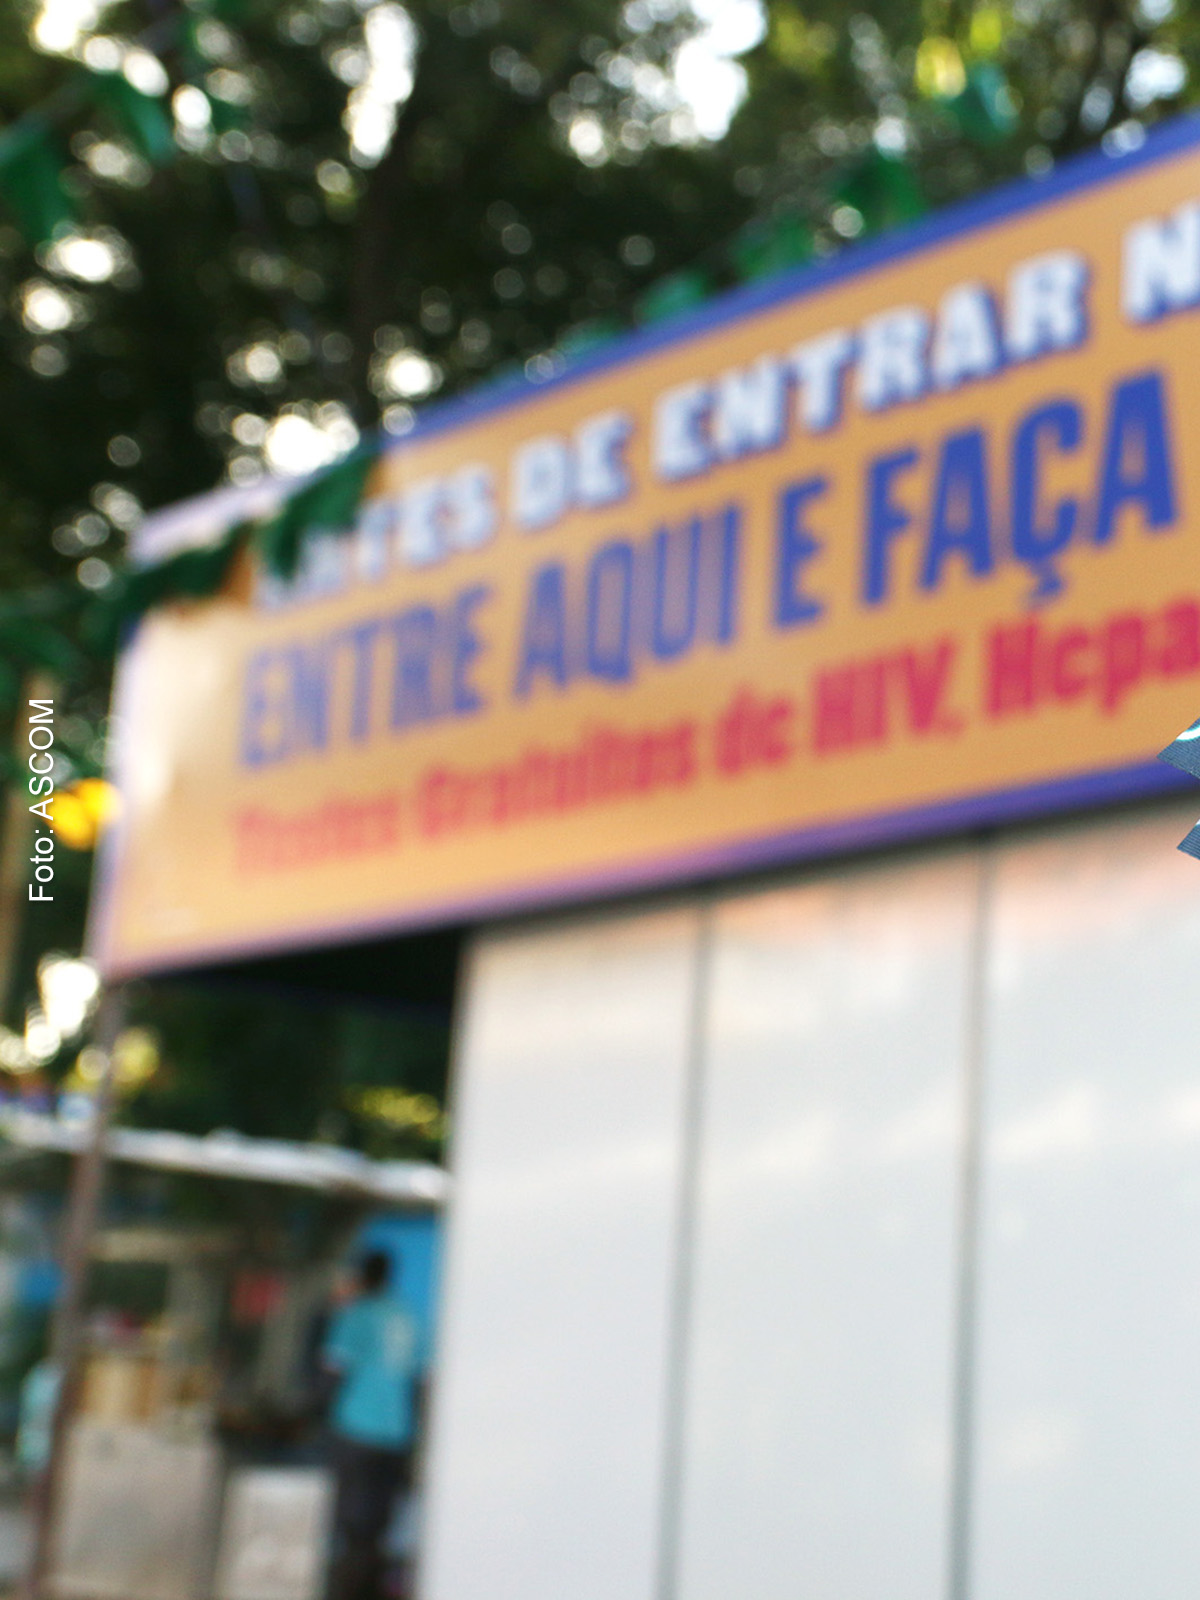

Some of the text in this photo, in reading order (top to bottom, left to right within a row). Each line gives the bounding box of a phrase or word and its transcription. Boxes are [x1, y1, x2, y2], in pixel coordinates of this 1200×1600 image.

[239, 581, 492, 770] ENTRE
[513, 503, 743, 704] AQUI
[773, 474, 829, 633] E
[859, 370, 1177, 611] FAÇA
[257, 462, 497, 612] NTES
[512, 408, 635, 530] DE
[651, 246, 1089, 482] ENTRAR
